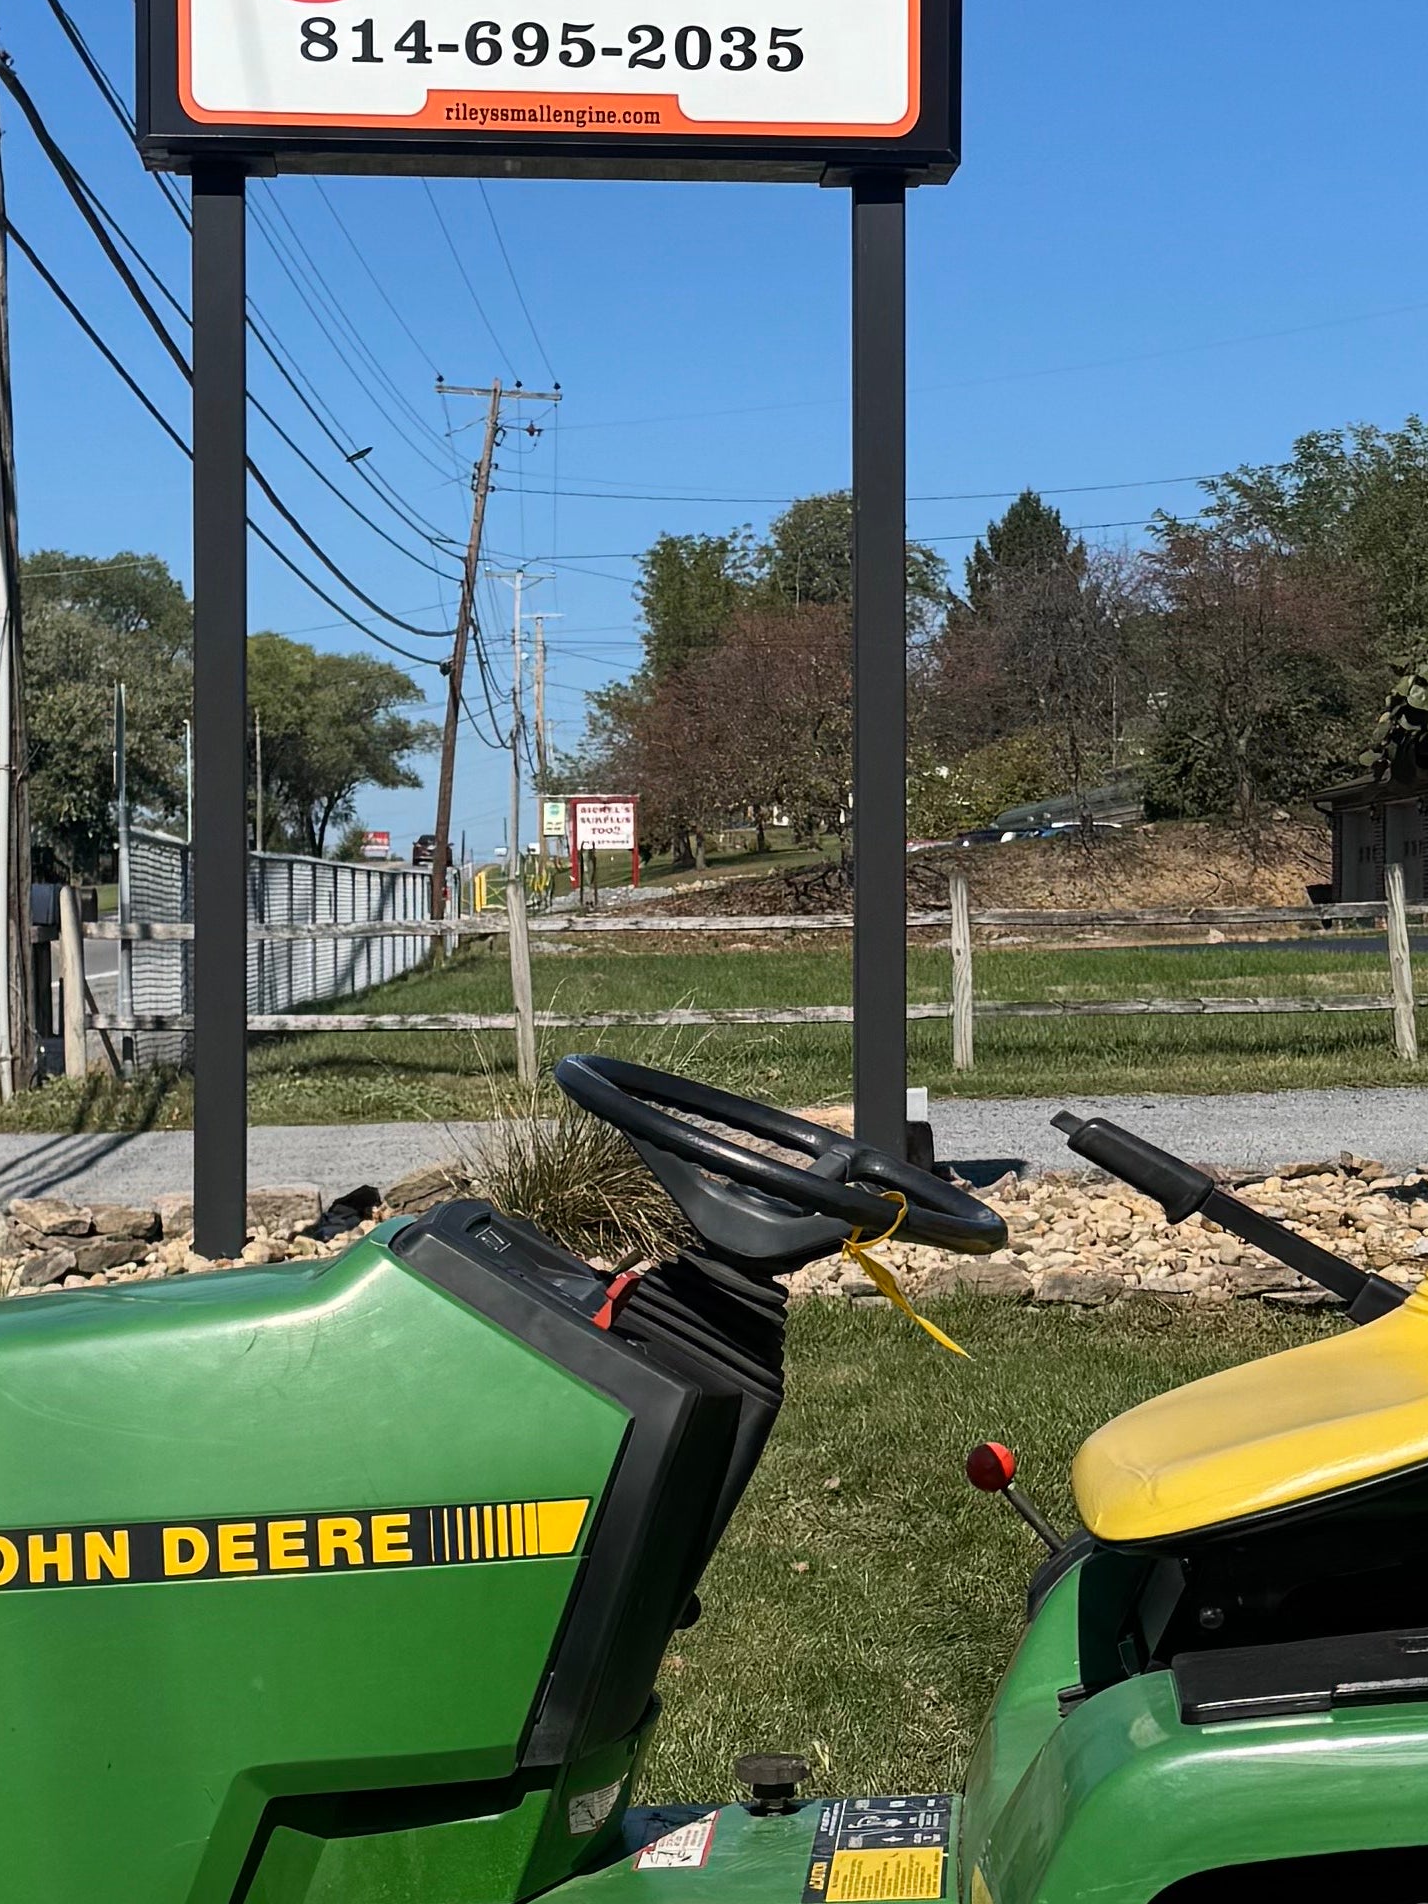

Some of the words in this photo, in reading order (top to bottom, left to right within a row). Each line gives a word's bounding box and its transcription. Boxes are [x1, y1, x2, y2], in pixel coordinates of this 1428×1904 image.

[300, 16, 804, 73] 814-695-2035
[445, 102, 662, 129] rileyssmallengine.com
[162, 1513, 412, 1577] DEERE
